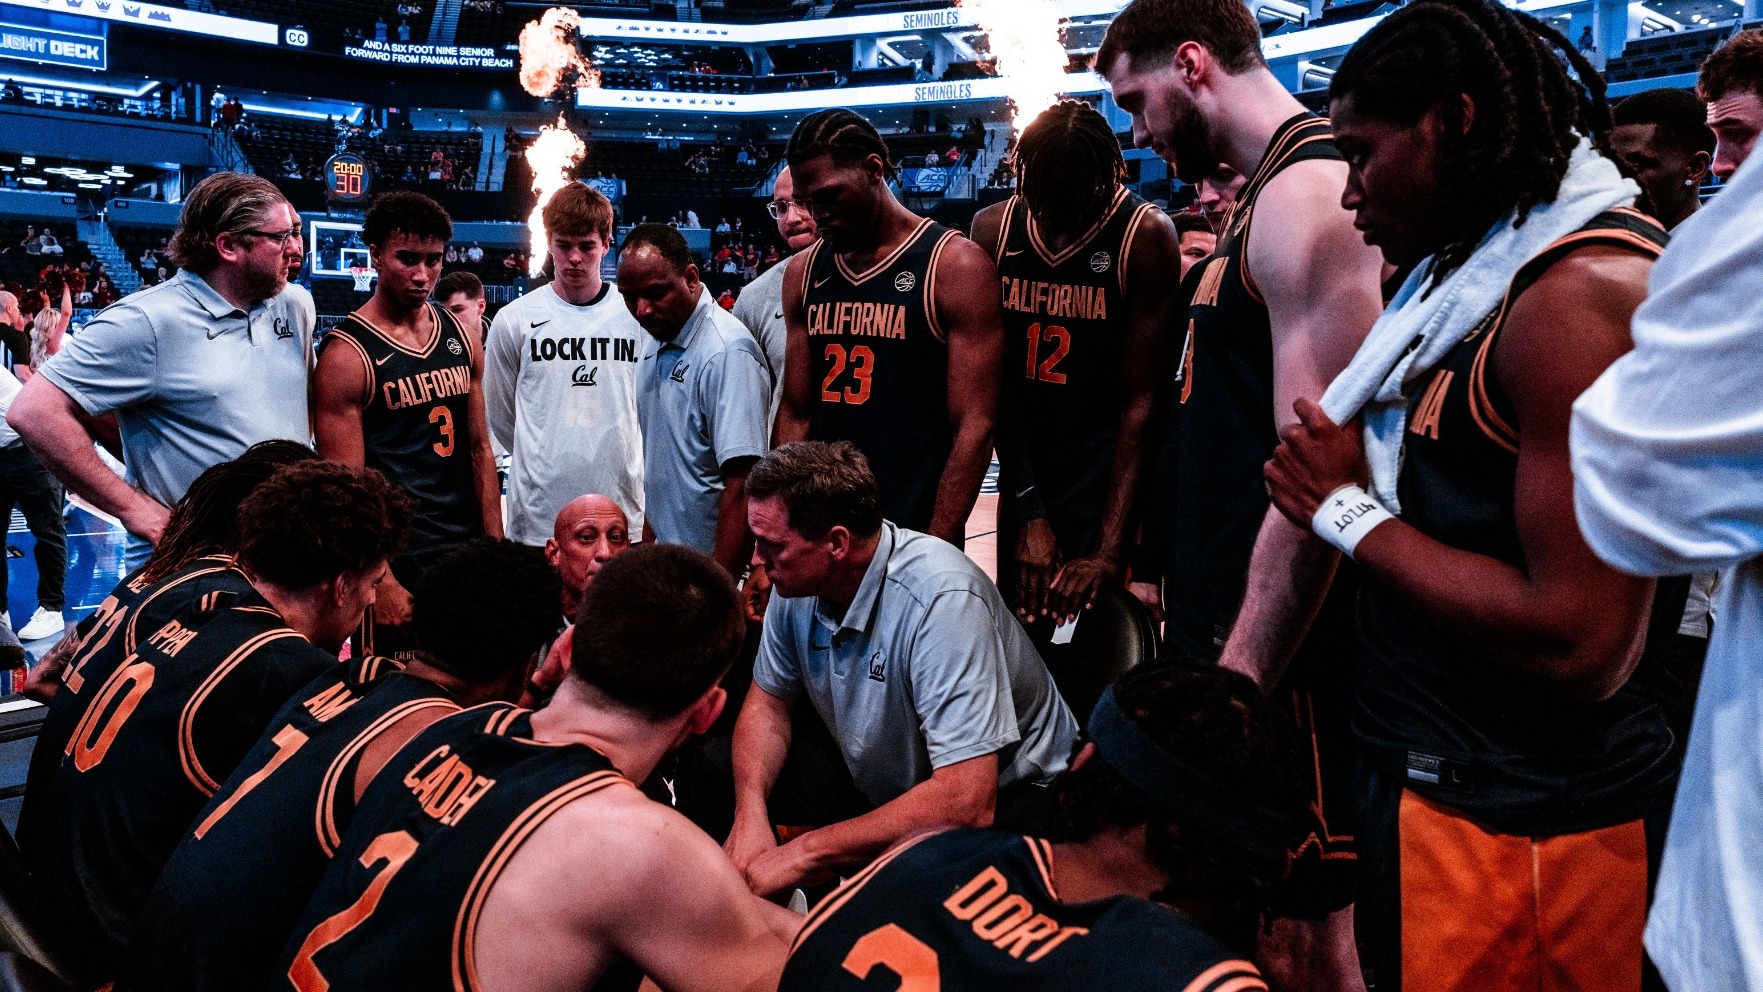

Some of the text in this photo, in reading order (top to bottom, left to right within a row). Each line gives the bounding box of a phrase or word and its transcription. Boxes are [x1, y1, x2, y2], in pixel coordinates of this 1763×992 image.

[903, 11, 959, 29] SEMINOLES
[50, 40, 100, 60] DECK
[288, 32, 306, 44] CC
[363, 39, 383, 50] AND
[383, 43, 391, 52] A
[391, 43, 407, 53] SIX
[408, 44, 434, 54] FOOT
[435, 46, 458, 56] NINE
[459, 47, 495, 57] SENIOR
[345, 46, 514, 68] FORWARD FROM PANAMA CITY BEACH
[914, 83, 972, 101] SEMINOLES
[333, 161, 363, 176] 20:00
[335, 173, 361, 195] 30
[1001, 275, 1107, 320] CALIFORNIA
[273, 317, 294, 340] Cal
[807, 301, 906, 340] CALIFORNIA
[530, 337, 638, 363] LOCK IT IN.
[1026, 322, 1072, 385] 12
[571, 364, 598, 387] Cal
[670, 359, 690, 383] Cal
[821, 343, 875, 405] 23
[429, 404, 456, 458] 3
[868, 650, 887, 682] Cal
[64, 652, 155, 773] 10
[193, 723, 310, 841] 7
[287, 829, 420, 992] 2
[943, 865, 1090, 964] DORT
